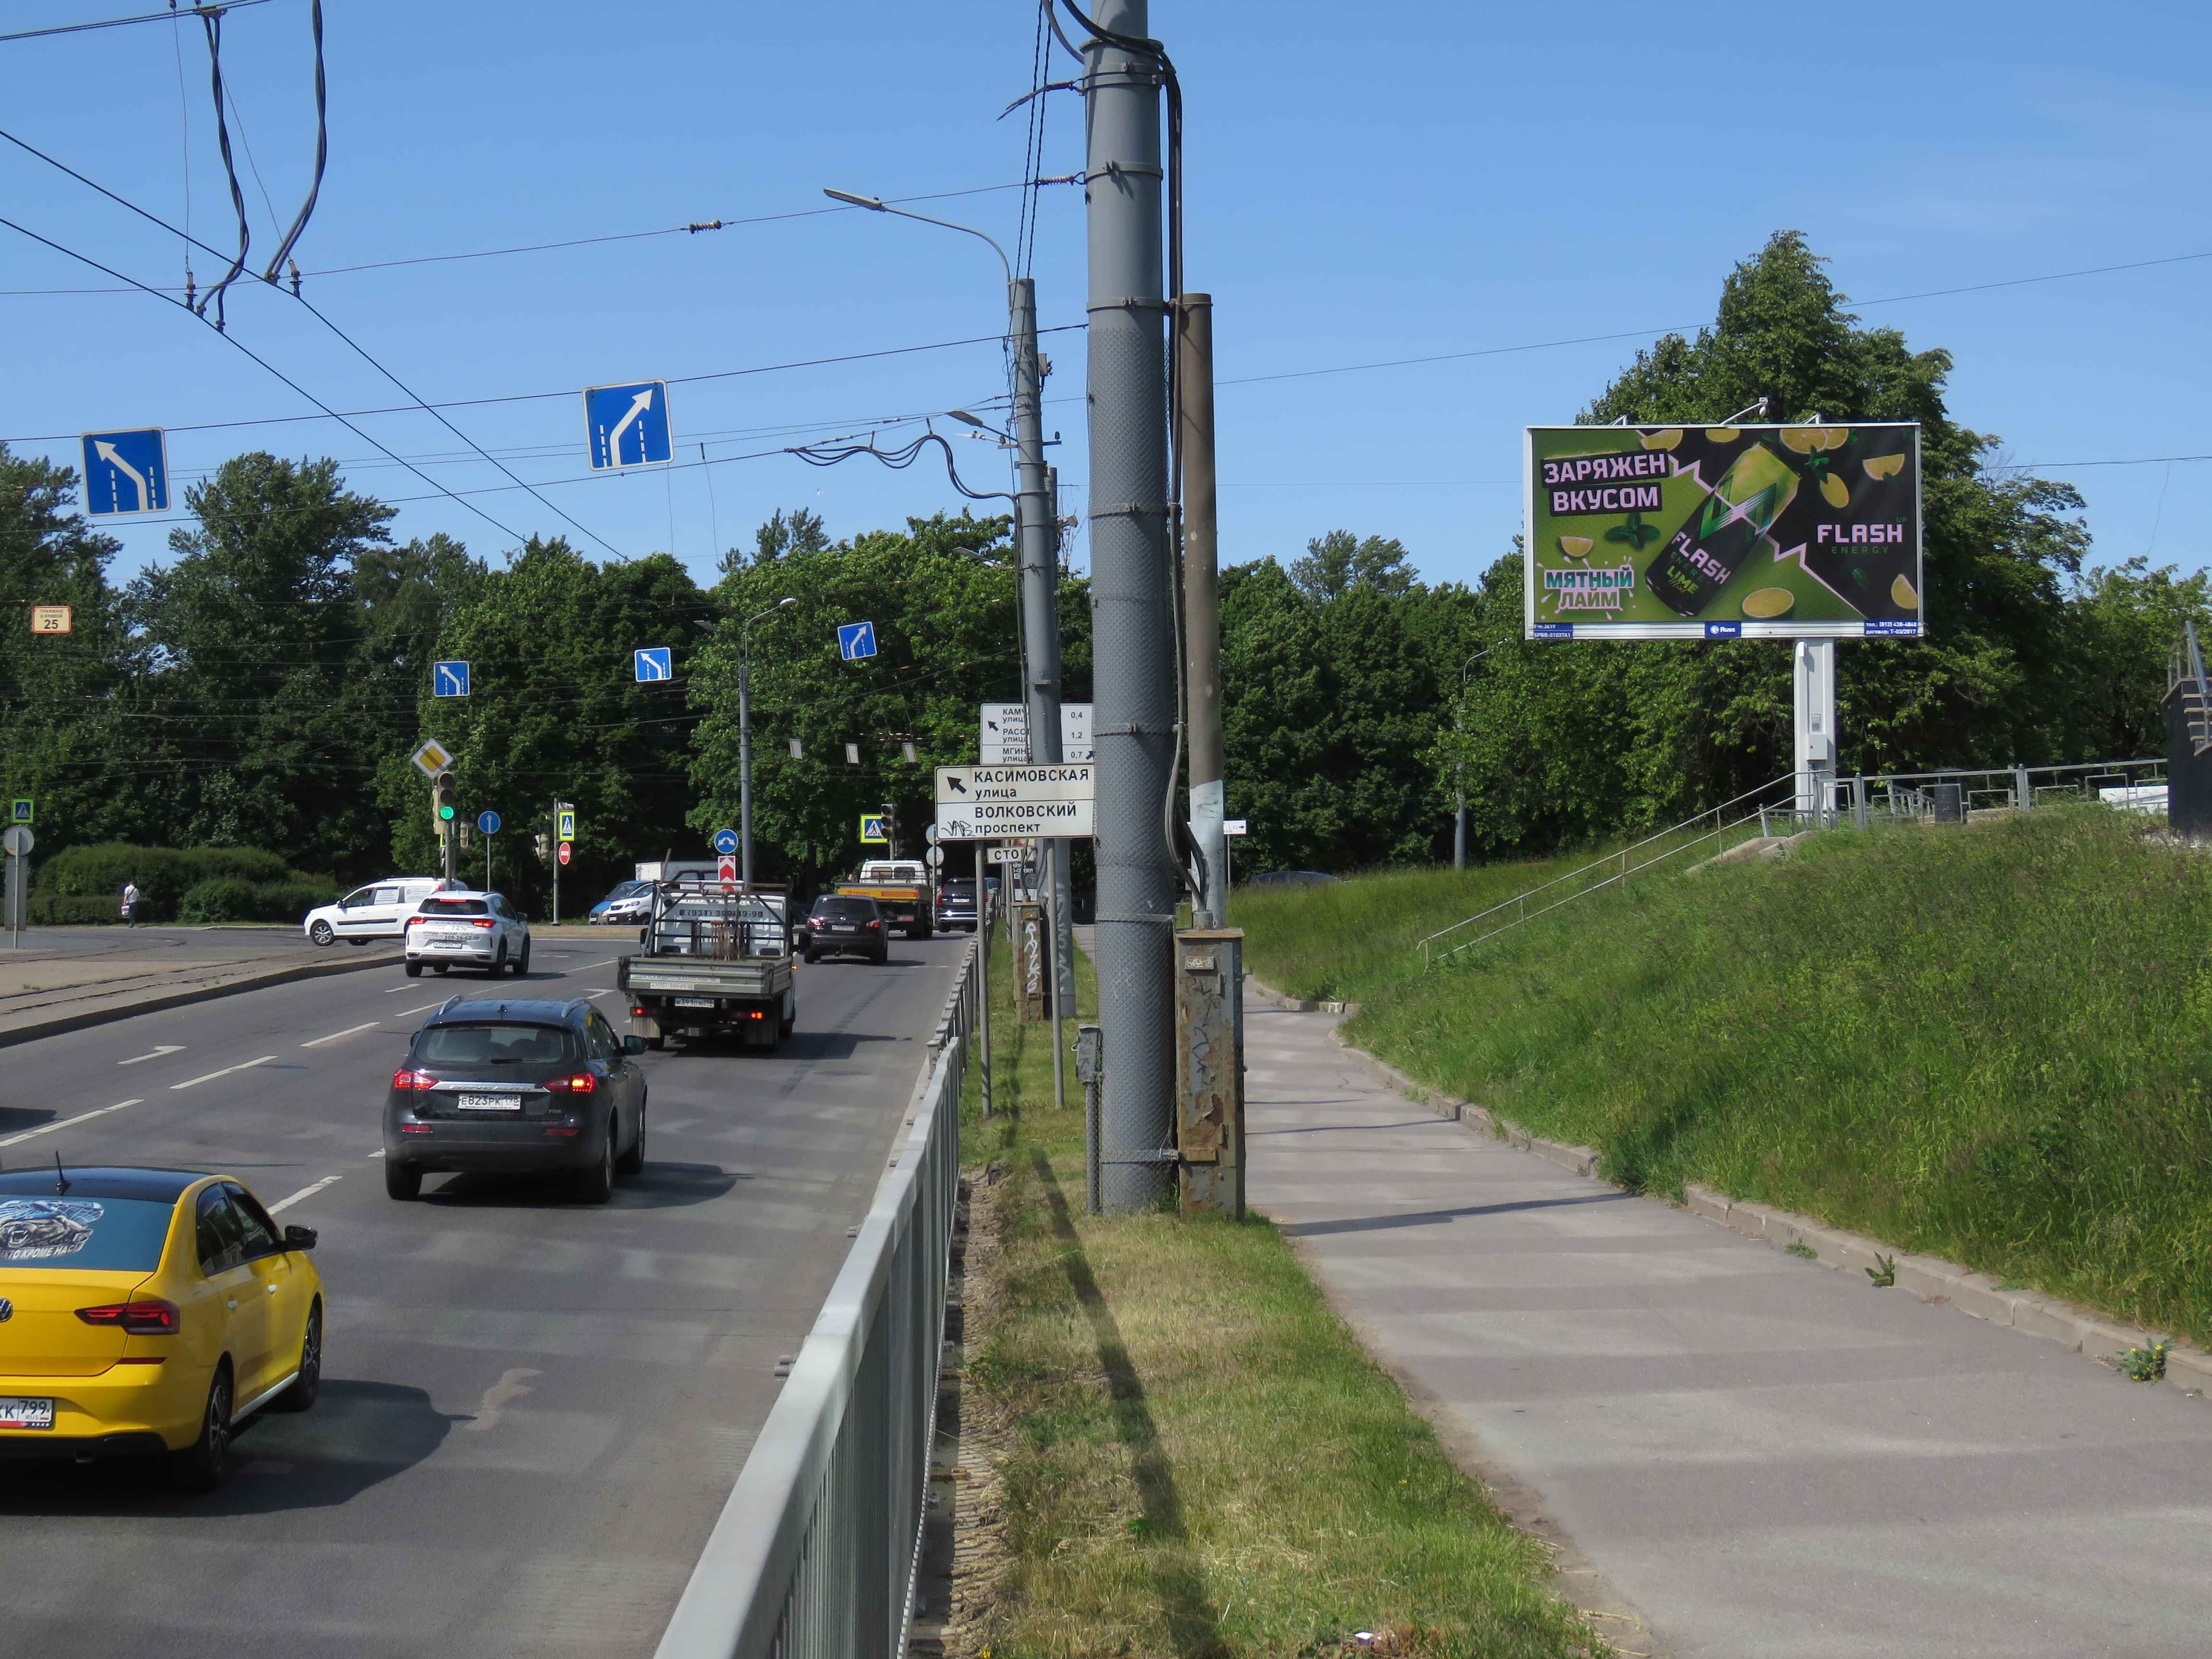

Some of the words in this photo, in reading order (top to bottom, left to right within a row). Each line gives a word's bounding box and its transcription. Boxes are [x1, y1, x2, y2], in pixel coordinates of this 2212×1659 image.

[1544, 453, 1666, 484] ЗАРЯЖЕН
[1553, 487, 1658, 512] ВКУСОМ
[1817, 524, 1903, 543] FLASH
[1671, 531, 1732, 584] FLASH
[1546, 566, 1633, 588] МЯТНЫЙ
[1667, 565, 1699, 594] LIME
[1560, 588, 1618, 607] ЛАЙМ
[44, 619, 59, 629] 25
[975, 769, 1089, 783] КАСИМОВСКАЯ
[975, 789, 1017, 800] улица
[975, 801, 1076, 818] ВОЛКОВСКИЙ
[975, 823, 1040, 835] проспект
[20, 1248, 53, 1258] КРОМЕ
[21, 1400, 47, 1415] 799
